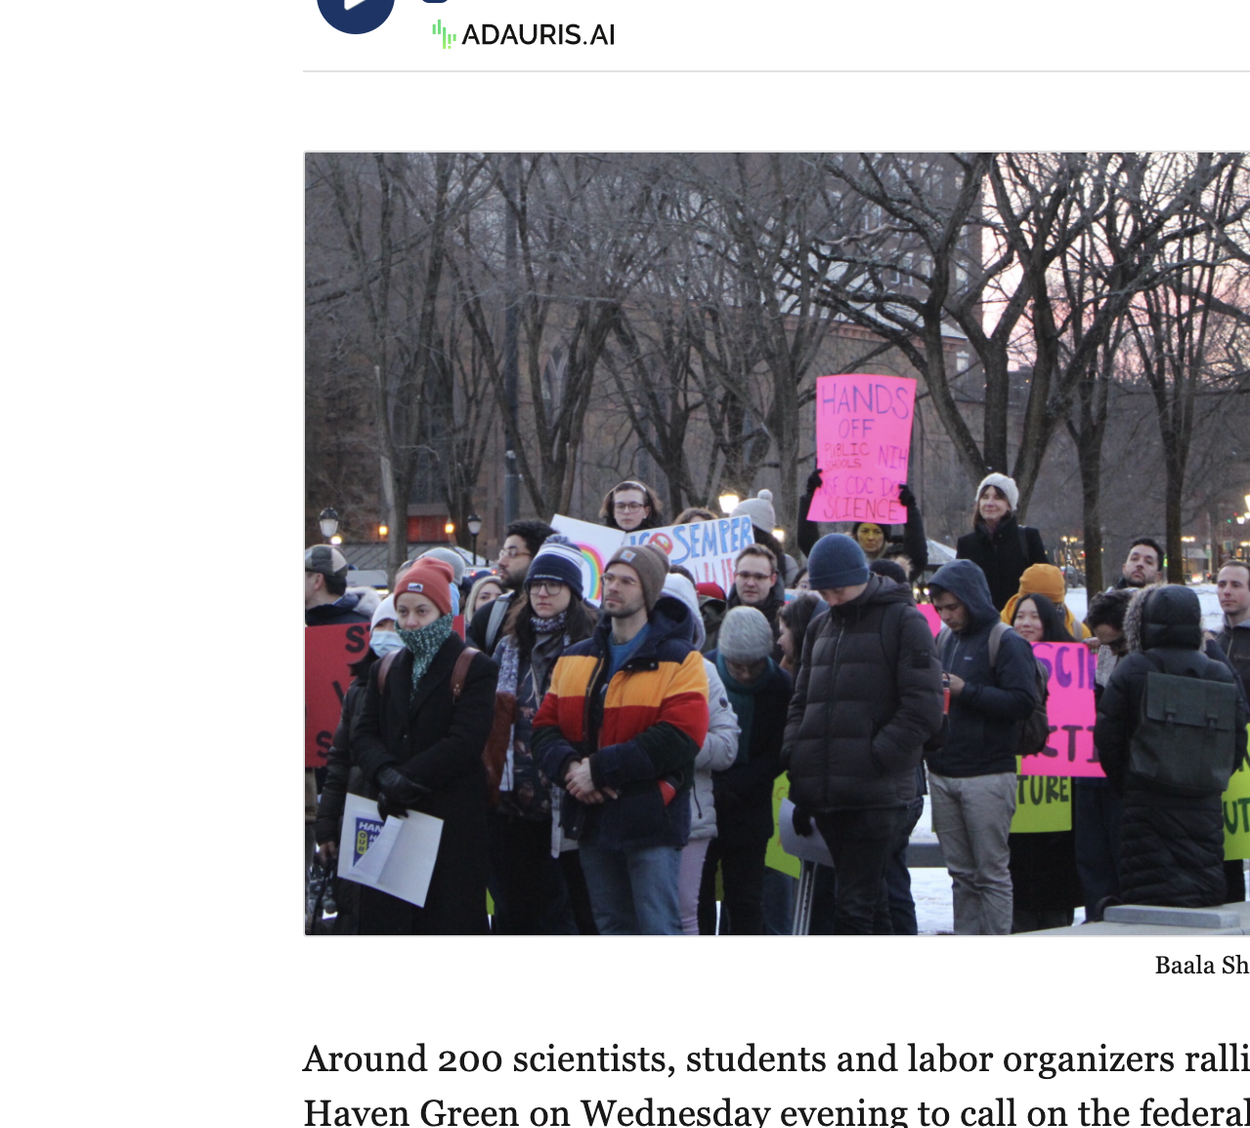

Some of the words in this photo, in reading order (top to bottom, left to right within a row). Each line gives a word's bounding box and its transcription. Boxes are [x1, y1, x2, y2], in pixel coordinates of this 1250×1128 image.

[462, 24, 614, 45] ADAURIS.AI
[822, 383, 909, 420] HANDS
[838, 419, 875, 439] OFF
[825, 442, 870, 458] PUBLIC
[878, 445, 908, 469] NIH
[846, 476, 874, 494] CDC
[882, 477, 905, 497] DO
[824, 496, 901, 521] SCIENCE
[671, 516, 752, 565] SEMPER
[359, 821, 383, 833] HAN
[1155, 955, 1215, 974] Baala
[302, 1043, 428, 1072] Around
[439, 1051, 502, 1072] 200
[514, 1043, 675, 1077] scientists,
[687, 1043, 826, 1072] students
[837, 1043, 898, 1072] and
[907, 1043, 993, 1072] labor
[1004, 1044, 1174, 1079] organizers
